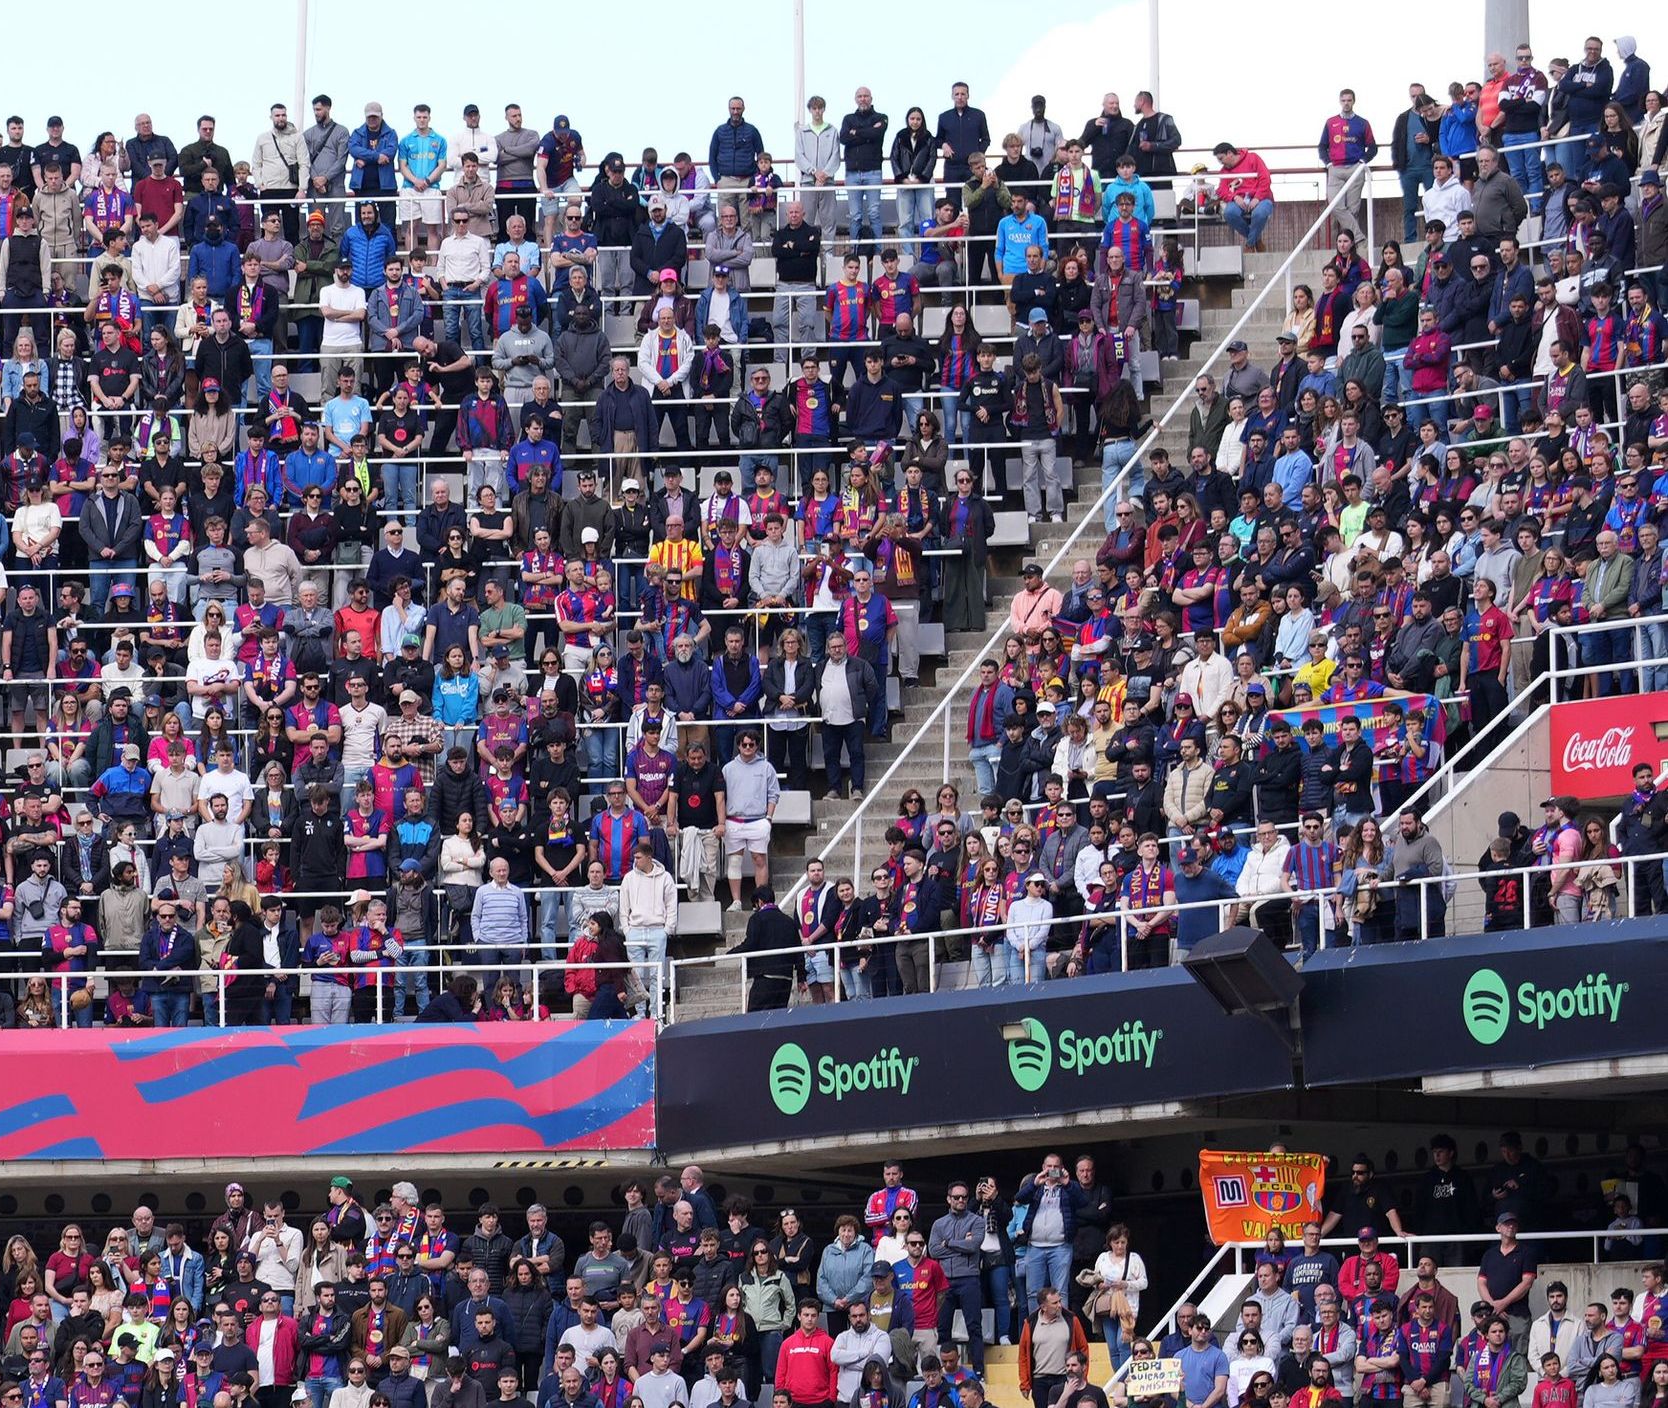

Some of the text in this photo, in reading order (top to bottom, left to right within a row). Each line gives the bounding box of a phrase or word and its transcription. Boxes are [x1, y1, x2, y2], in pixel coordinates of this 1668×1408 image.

[1563, 726, 1634, 772] Coca-Cola
[639, 772, 665, 782] Rakuten
[1493, 880, 1518, 902] 26
[1518, 973, 1622, 1029] Spotify
[1058, 1020, 1156, 1073] Spotify
[818, 1047, 912, 1100] Spotify
[898, 1282, 918, 1290] unicef
[1411, 1342, 1436, 1350] QATAR
